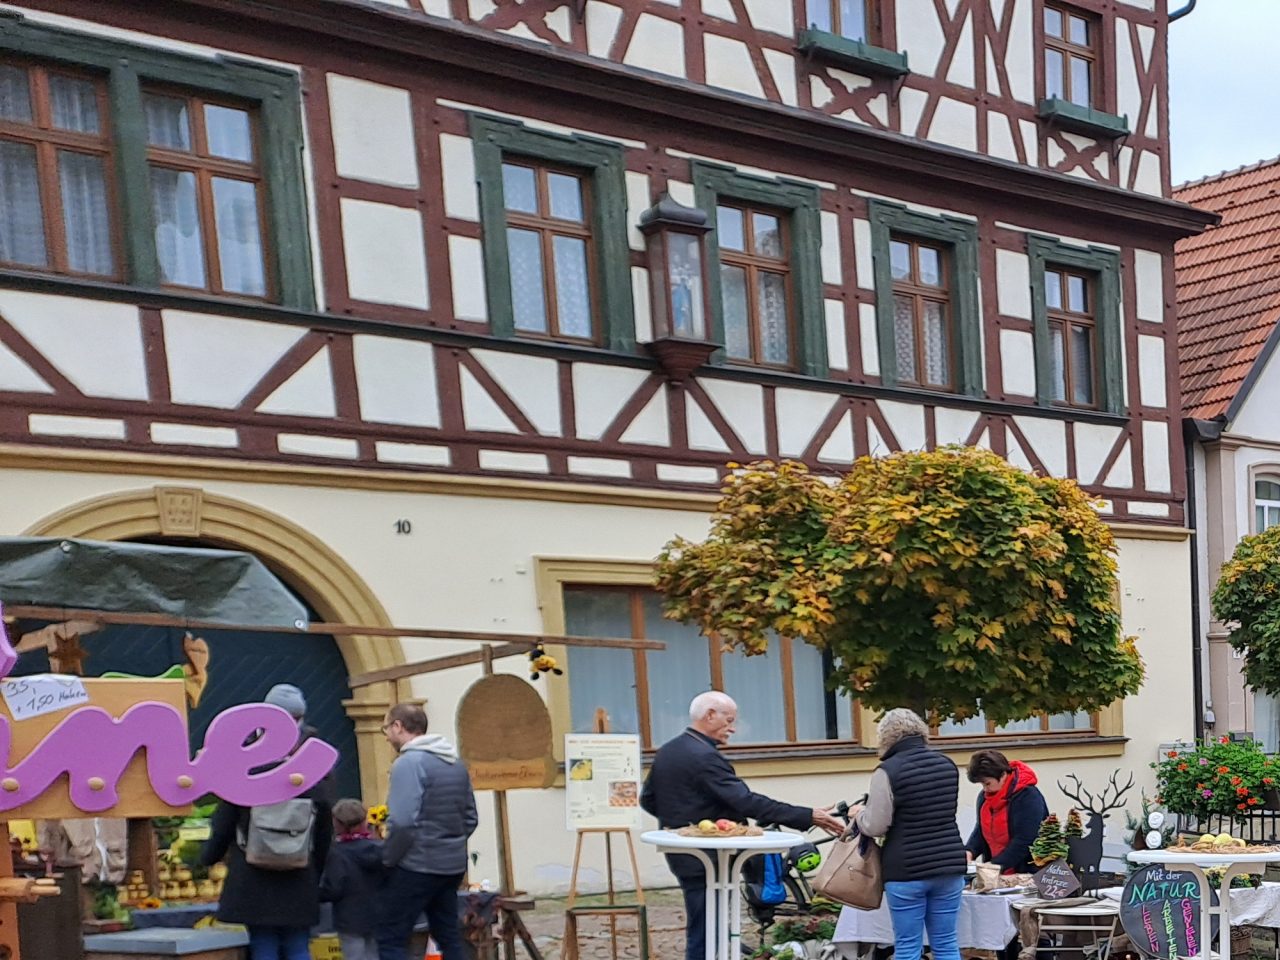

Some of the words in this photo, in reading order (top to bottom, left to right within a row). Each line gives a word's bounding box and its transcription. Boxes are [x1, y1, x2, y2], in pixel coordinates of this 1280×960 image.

[393, 519, 411, 534] 10
[1143, 868, 1163, 882] Mit
[1165, 870, 1182, 880] der
[1128, 881, 1200, 905] NATUR
